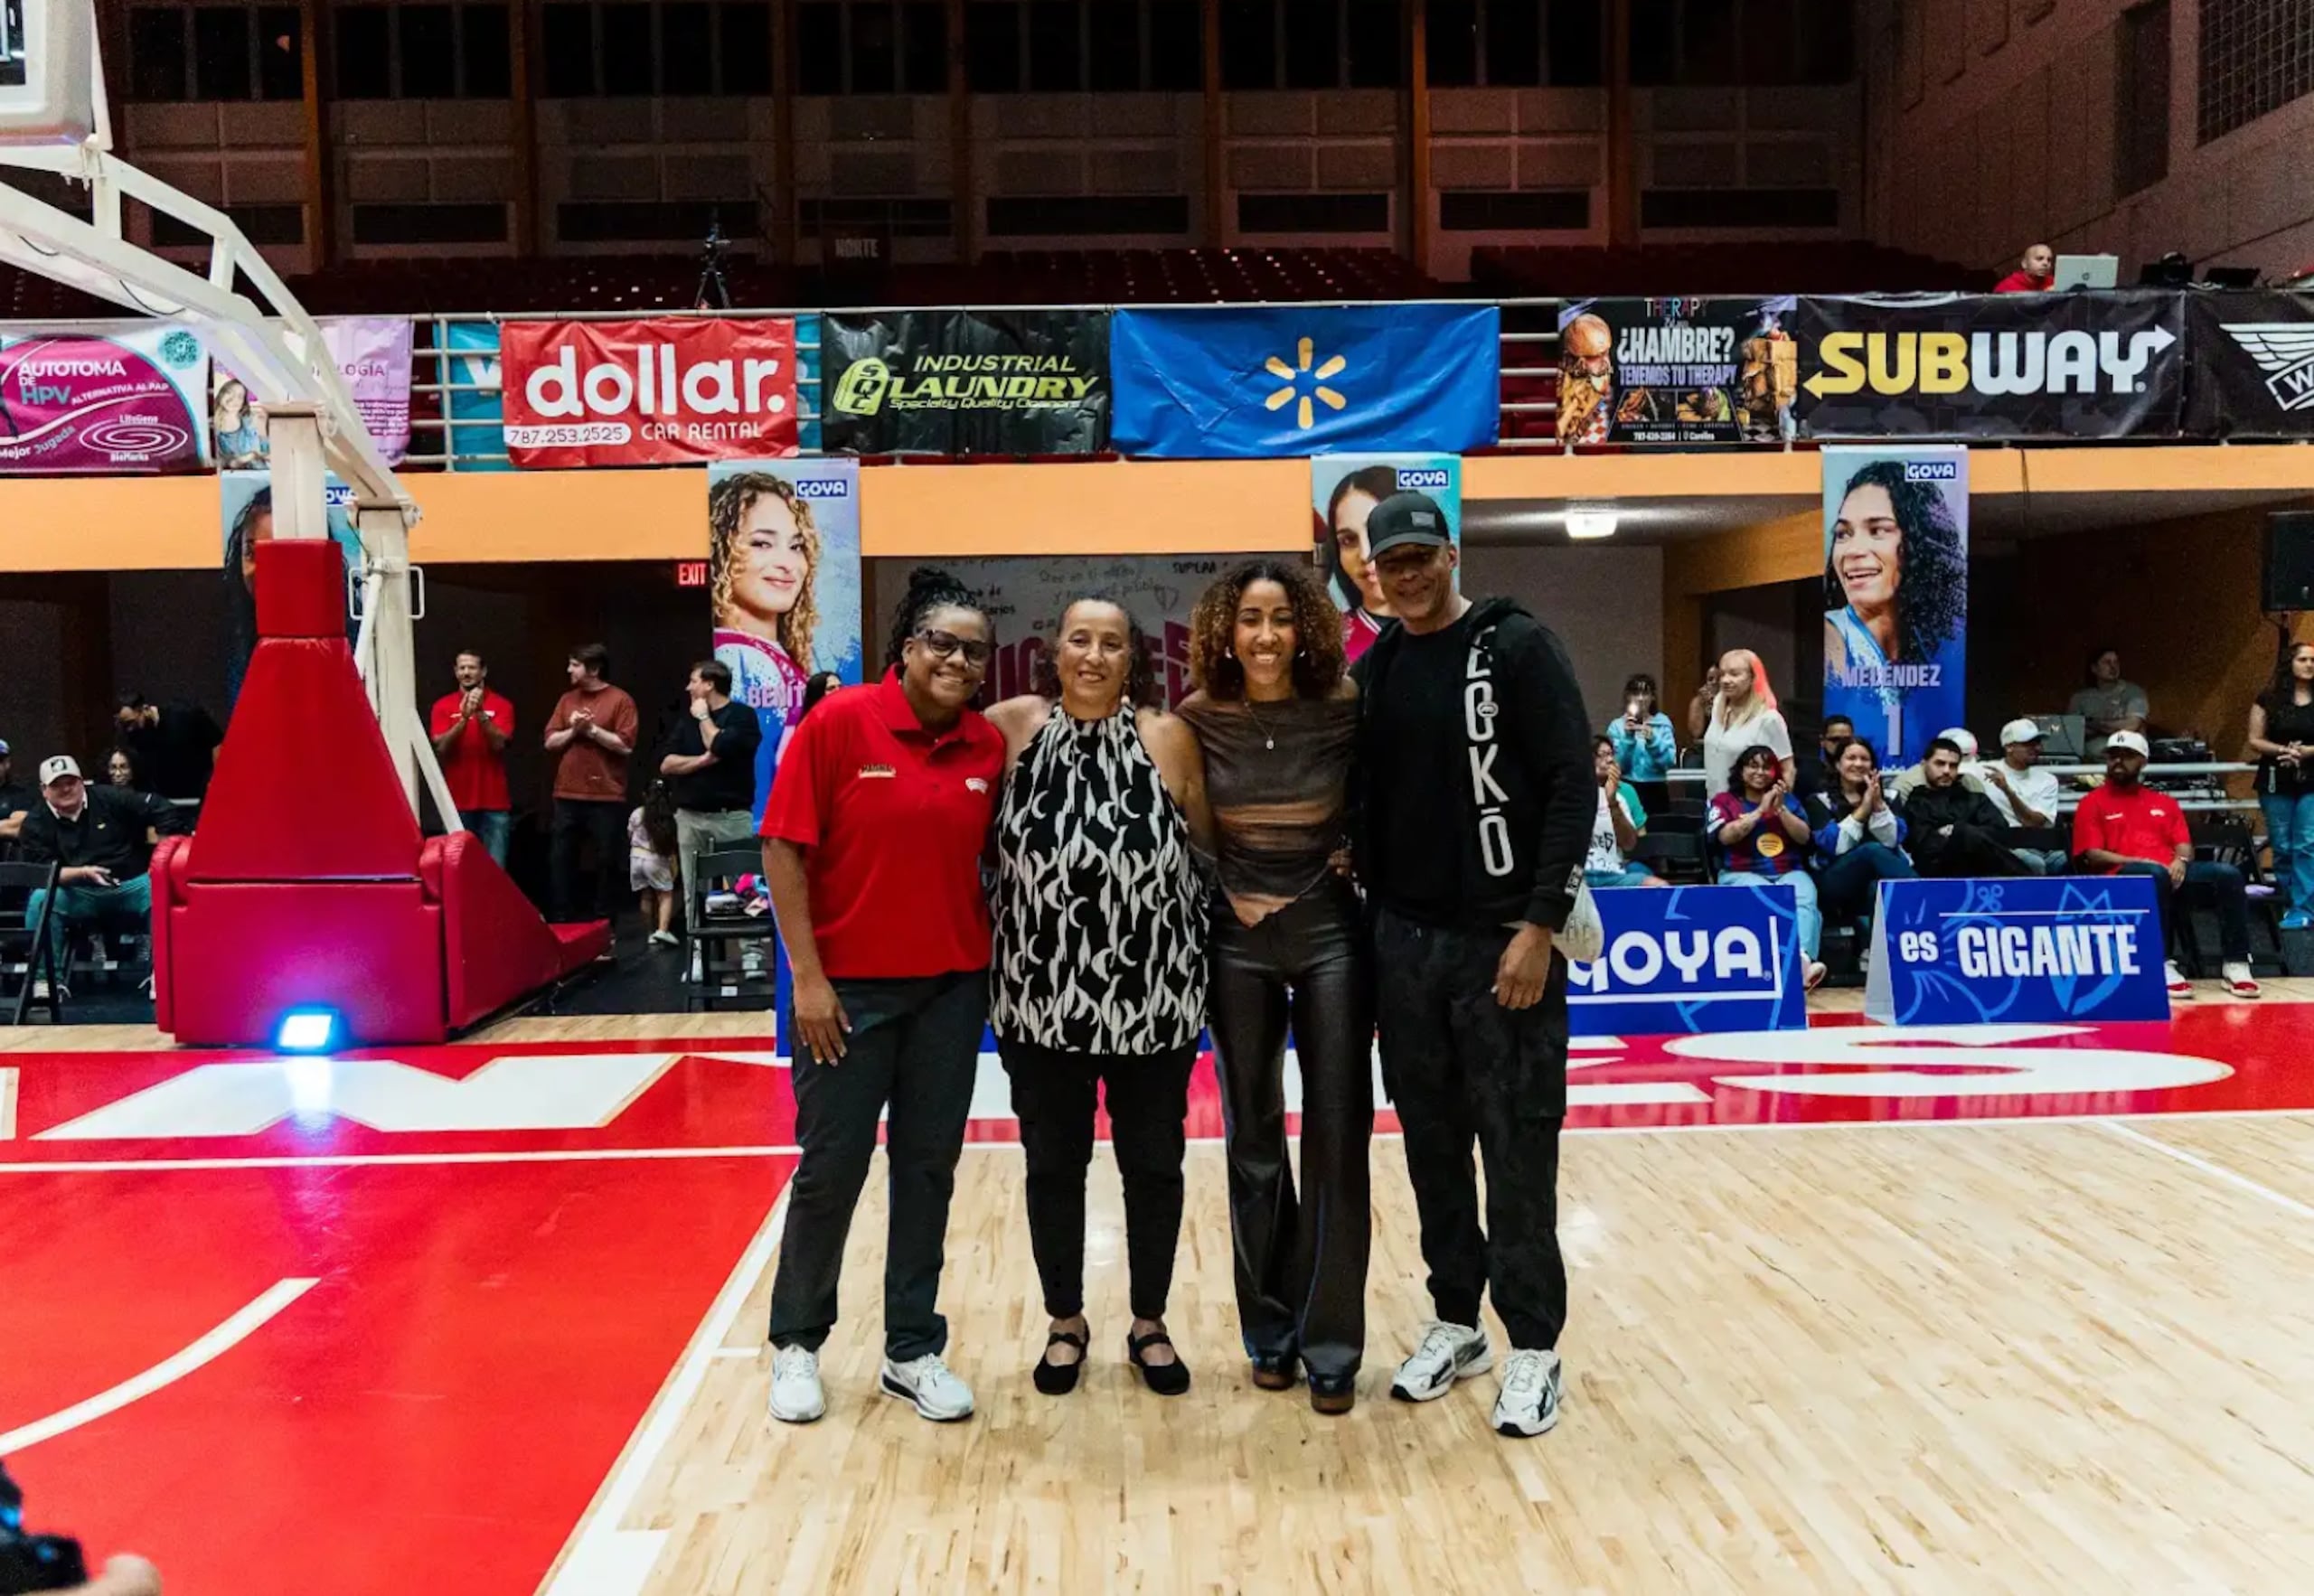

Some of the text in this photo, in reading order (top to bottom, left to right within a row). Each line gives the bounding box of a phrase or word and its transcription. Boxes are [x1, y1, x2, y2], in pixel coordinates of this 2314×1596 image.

[1616, 327, 1735, 363] ¿HAMBRE?
[17, 360, 127, 377] AUTOTOMA
[913, 354, 1077, 372] INDUSTRIAL
[1803, 324, 2177, 399] SUBWAY
[18, 376, 36, 386] DE
[1618, 365, 1738, 386] TENEMOS TU THERAPY
[20, 386, 71, 405] HPV
[71, 383, 134, 406] ALTERNATIVA
[888, 375, 1100, 399] LAUNDRY
[889, 399, 959, 409] Specialty
[961, 398, 1014, 409] Quality
[510, 421, 763, 445] 787.253.2525 CAR RENTAL
[1399, 471, 1447, 487] GOYA
[1907, 463, 1955, 479] GOYA
[797, 482, 846, 497] GOYA
[679, 563, 706, 585] EXIT
[1882, 704, 1904, 756] 1
[1900, 923, 2141, 978] es GIGANTE
